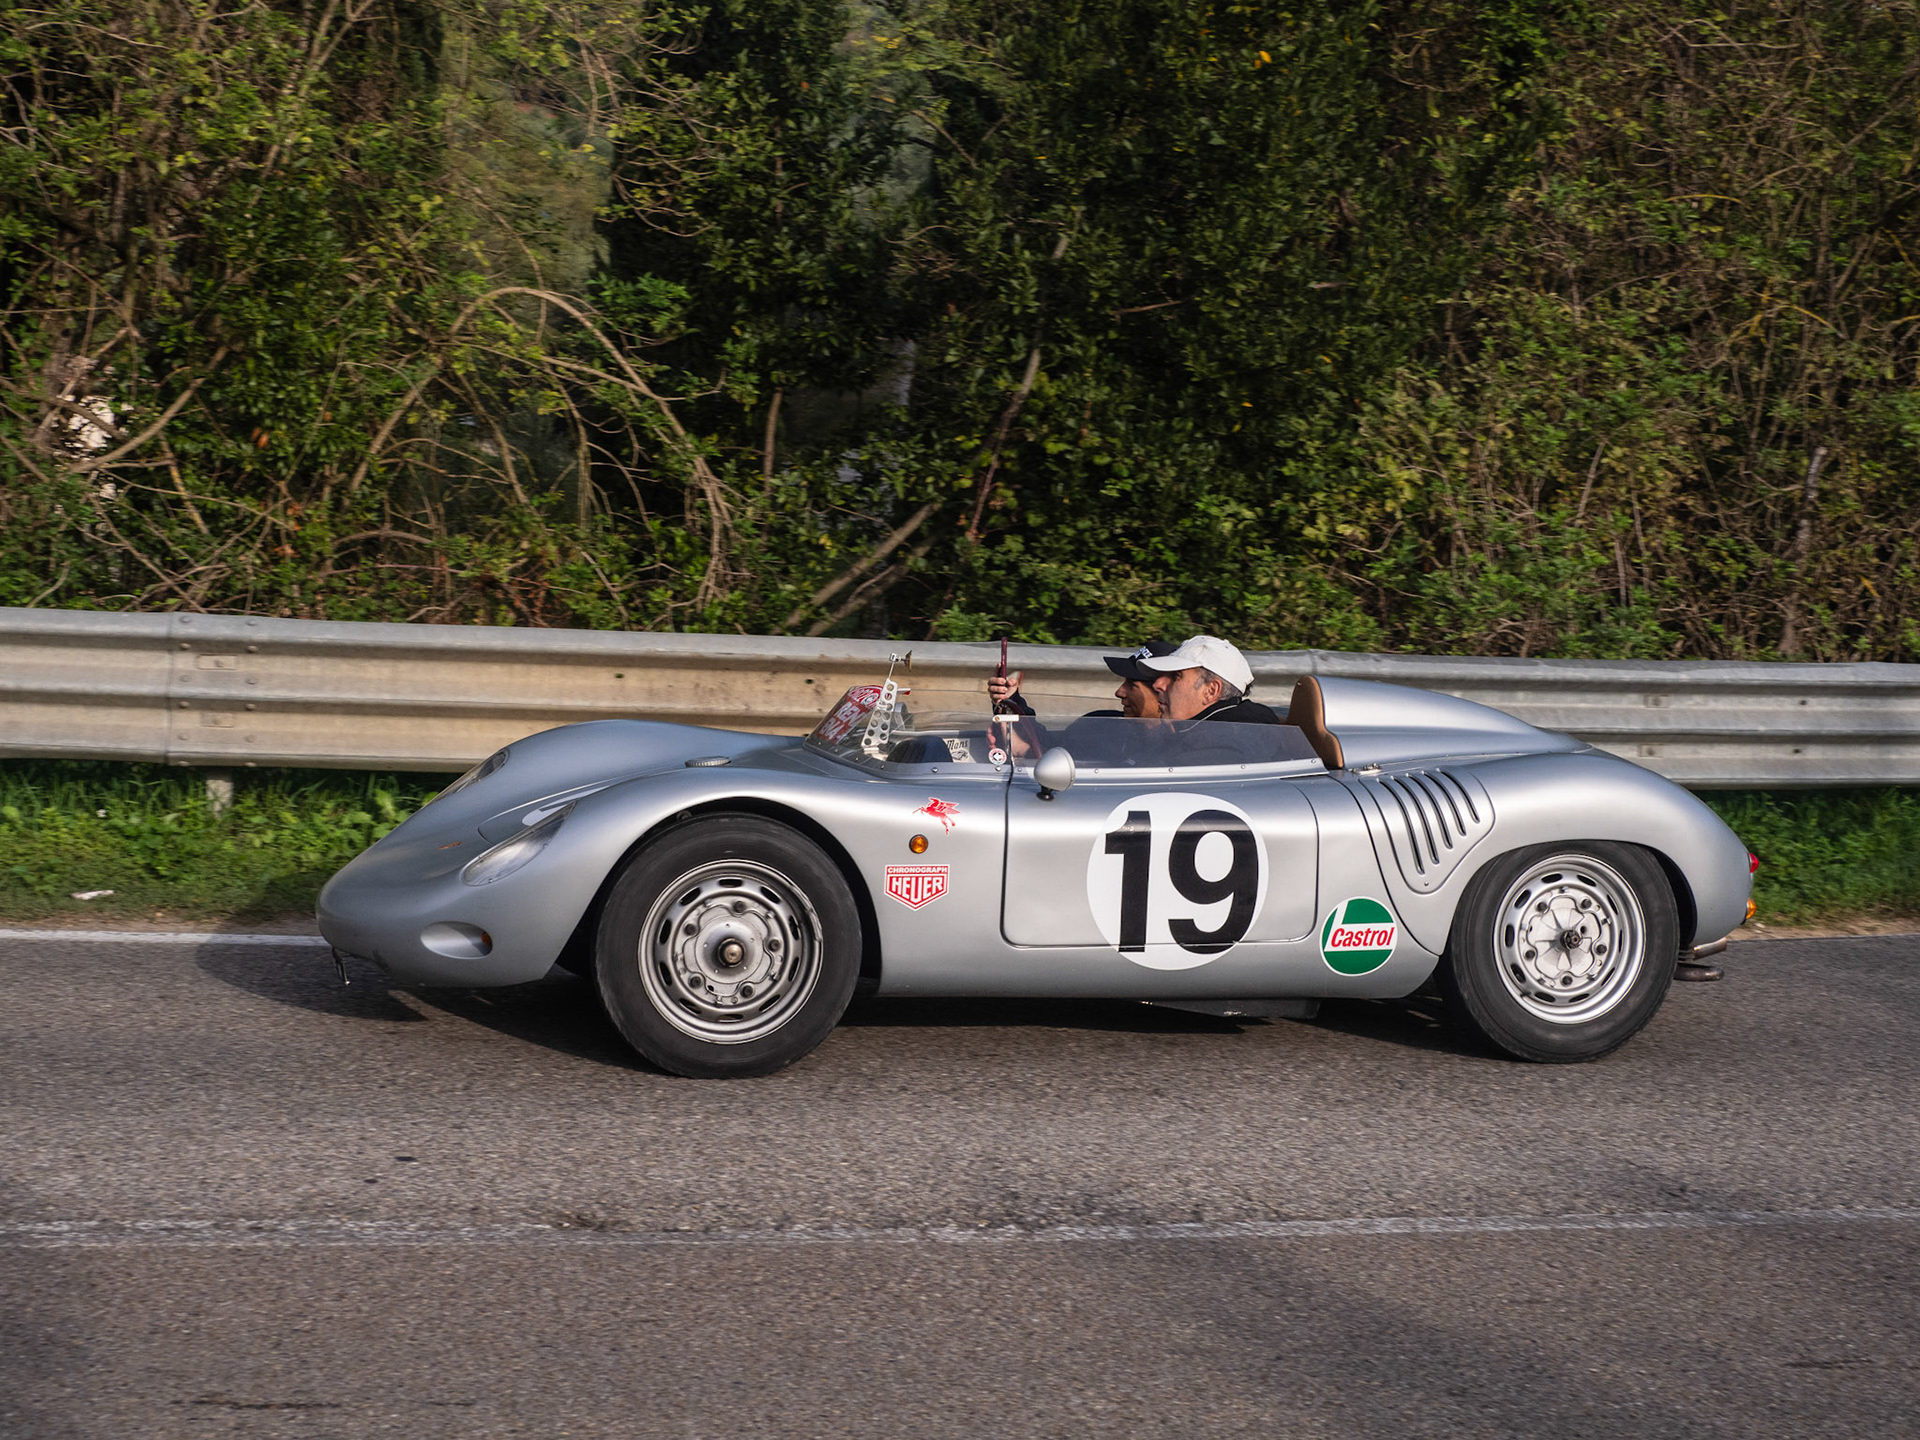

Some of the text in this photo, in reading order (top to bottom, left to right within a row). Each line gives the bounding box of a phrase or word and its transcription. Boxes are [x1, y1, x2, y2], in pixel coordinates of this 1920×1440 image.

[887, 866, 948, 874] CHRONOGRAPH
[1104, 809, 1259, 955] 19
[891, 876, 944, 903] HEUER
[1331, 926, 1396, 948] Castrol
